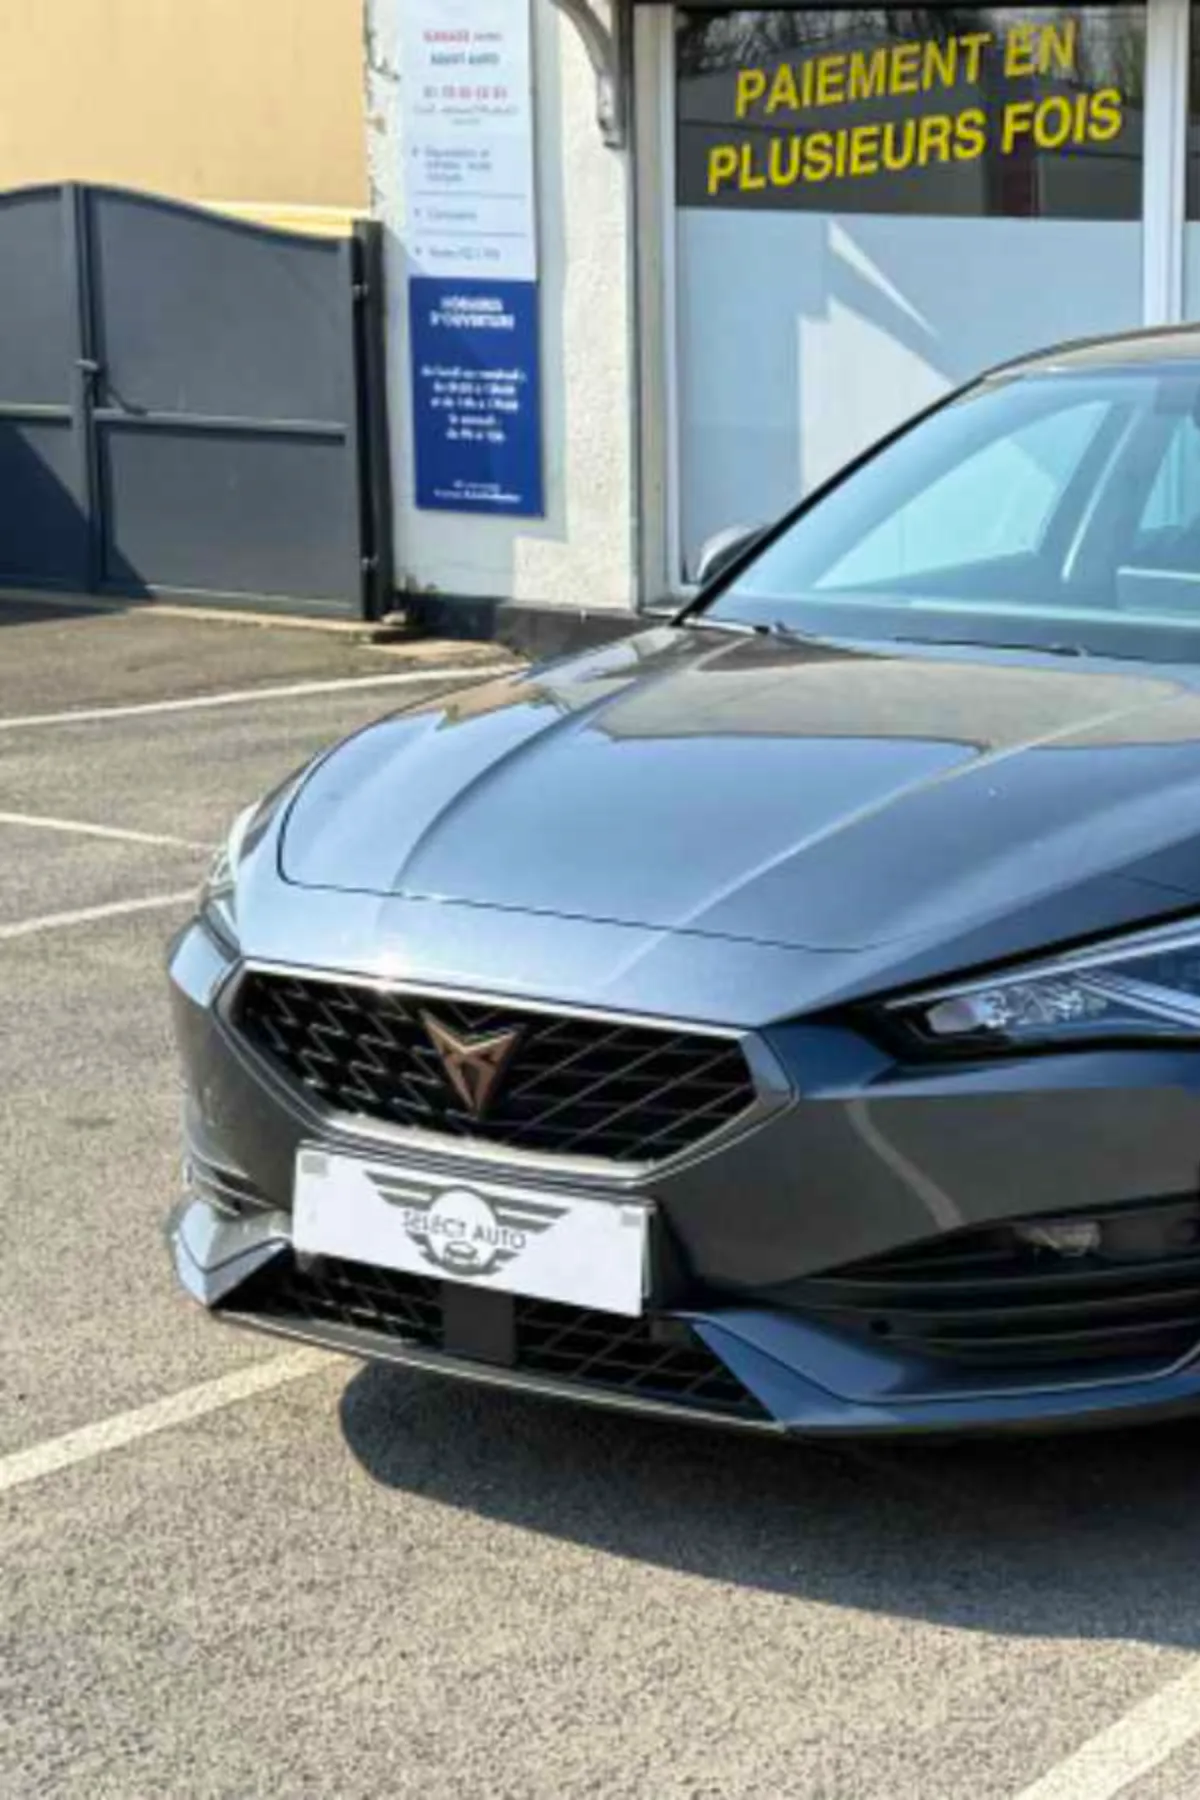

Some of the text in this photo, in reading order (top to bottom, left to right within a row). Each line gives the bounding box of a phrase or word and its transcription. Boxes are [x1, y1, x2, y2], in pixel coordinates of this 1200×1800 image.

[735, 19, 1077, 119] PAIEMENT EN
[707, 88, 1124, 196] PLUSIEURS FOIS
[471, 1224, 527, 1250] AUTO
